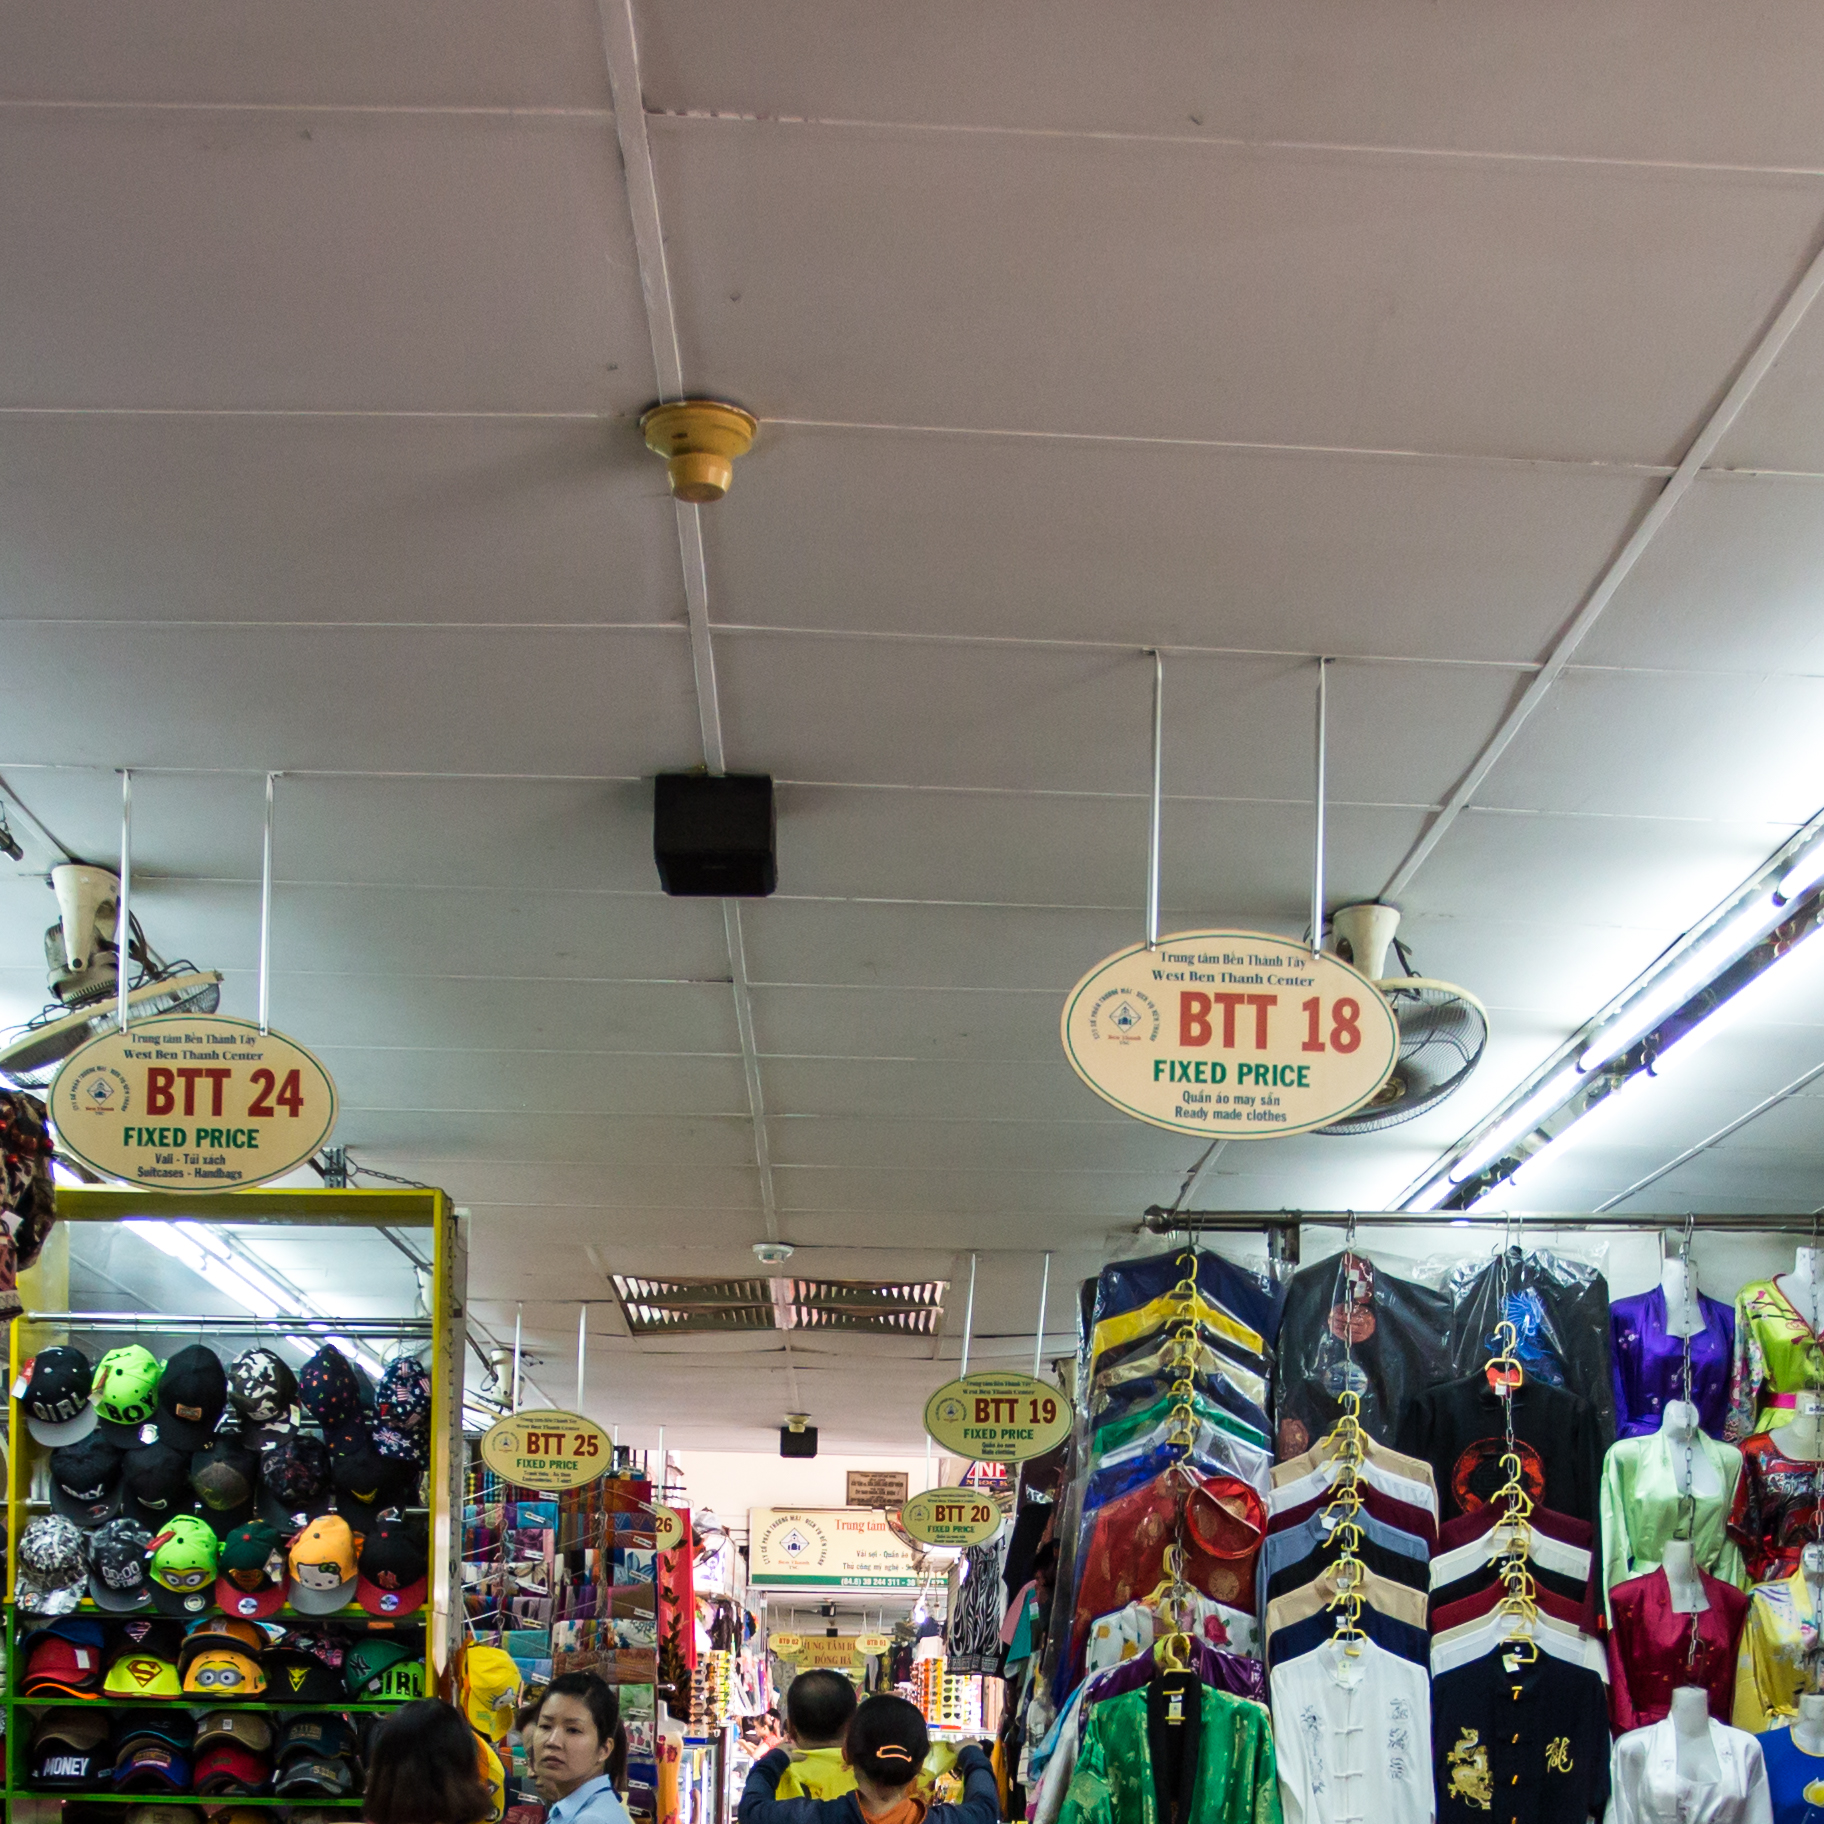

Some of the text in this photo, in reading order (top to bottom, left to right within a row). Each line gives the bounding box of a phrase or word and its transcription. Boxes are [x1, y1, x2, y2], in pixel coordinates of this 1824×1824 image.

[1160, 951, 1195, 967] Trung
[1197, 952, 1220, 966] tâm
[1246, 952, 1283, 968] Thành
[1285, 955, 1306, 971] Tây
[1151, 968, 1315, 988] West Ben Thanh Center
[1179, 990, 1362, 1054] BTT 18
[131, 1033, 161, 1046] Trung
[239, 1034, 256, 1047] Tây
[123, 1049, 264, 1061] West Ben Thanh Center
[1153, 1058, 1311, 1088] FIXED PRICE
[146, 1067, 304, 1118] BTT 24
[1215, 1091, 1230, 1105] áo
[1233, 1095, 1257, 1108] may
[1175, 1105, 1287, 1122] Ready made clothes
[123, 1127, 260, 1149] FIXED PRICE
[155, 1153, 173, 1165] Vali
[137, 1166, 243, 1181] Suitcases Handbags
[104, 1388, 156, 1421] BOY
[975, 1397, 1057, 1424] BTT 19
[963, 1428, 1034, 1440] FIXED PRICE
[527, 1432, 599, 1457] BTT 25
[516, 1458, 579, 1471] FIXED PRICE
[935, 1505, 991, 1523] BTT 20
[656, 1517, 673, 1533] 26
[835, 1518, 886, 1534] Trung tâm
[927, 1525, 975, 1533] FIXED PRICE
[887, 1578, 900, 1587] 311
[1545, 1736, 1574, 1774] 龍
[43, 1757, 90, 1777] MONEY
